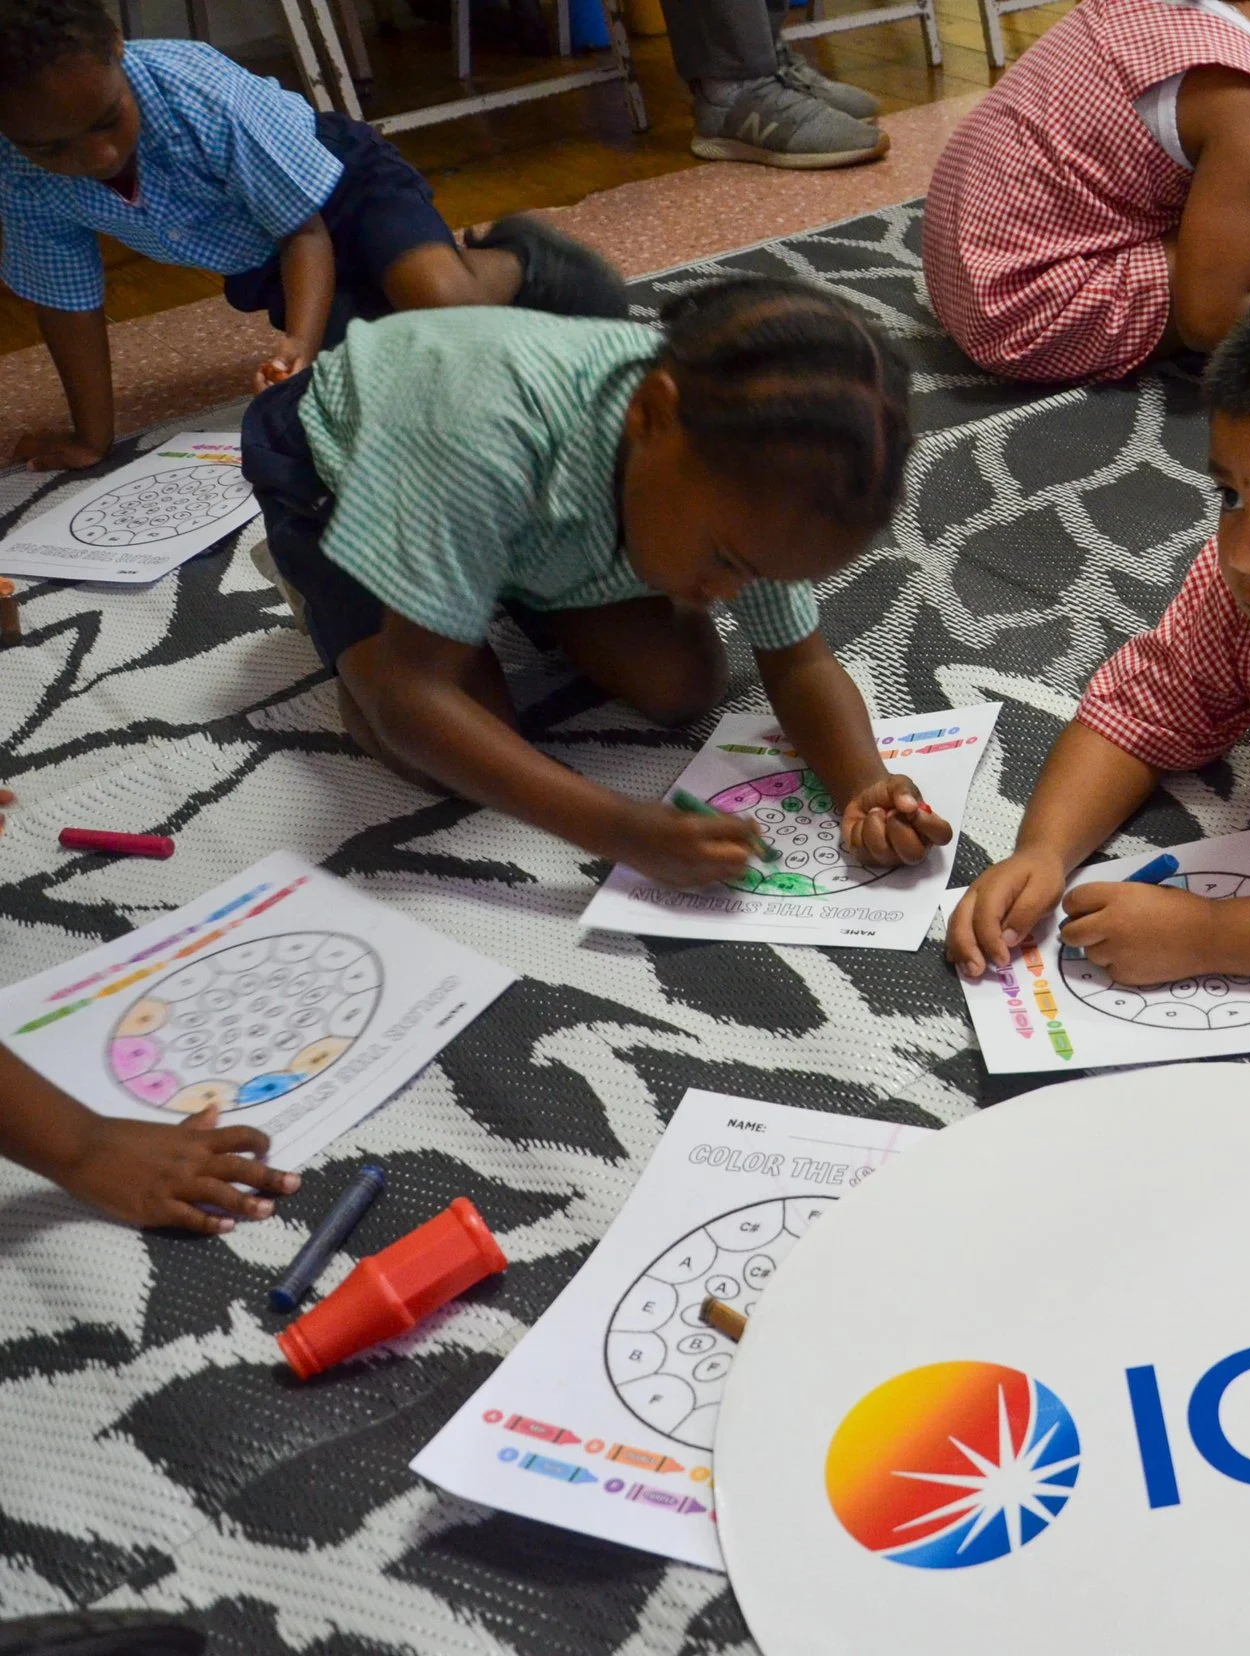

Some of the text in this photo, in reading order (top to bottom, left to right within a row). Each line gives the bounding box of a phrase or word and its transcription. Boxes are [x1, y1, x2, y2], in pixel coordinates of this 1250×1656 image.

[1205, 882, 1218, 892] A
[628, 886, 905, 922] COLOR THE STEELPAN
[726, 1118, 767, 1133] NAME:
[689, 1144, 785, 1176] COLOR
[791, 1157, 848, 1185] THE
[739, 1222, 761, 1233] C#
[749, 1267, 771, 1278] C#
[707, 1362, 721, 1372] F
[649, 1394, 664, 1405] F
